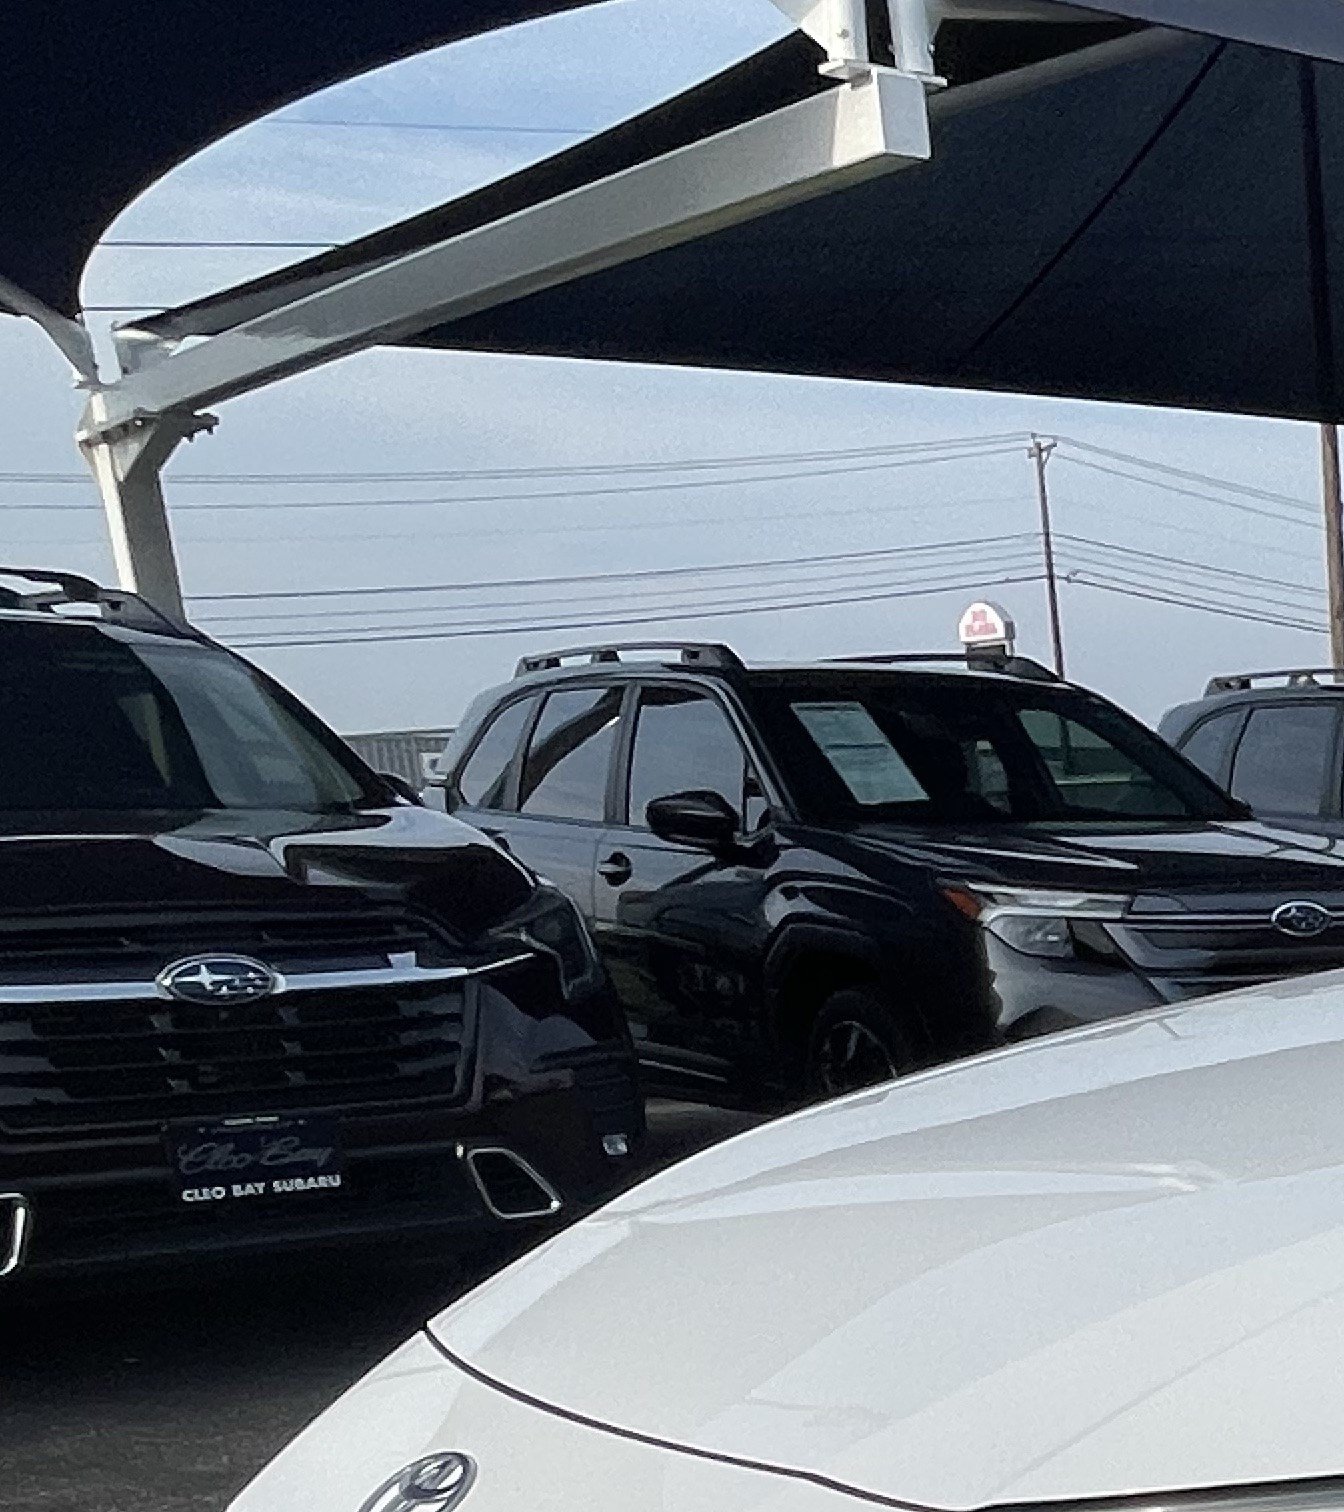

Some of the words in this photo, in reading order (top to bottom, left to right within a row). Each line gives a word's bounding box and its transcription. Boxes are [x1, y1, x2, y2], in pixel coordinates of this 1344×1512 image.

[181, 1186, 226, 1202] CLEO
[231, 1182, 266, 1197] BAY
[272, 1174, 342, 1192] SUBARU
